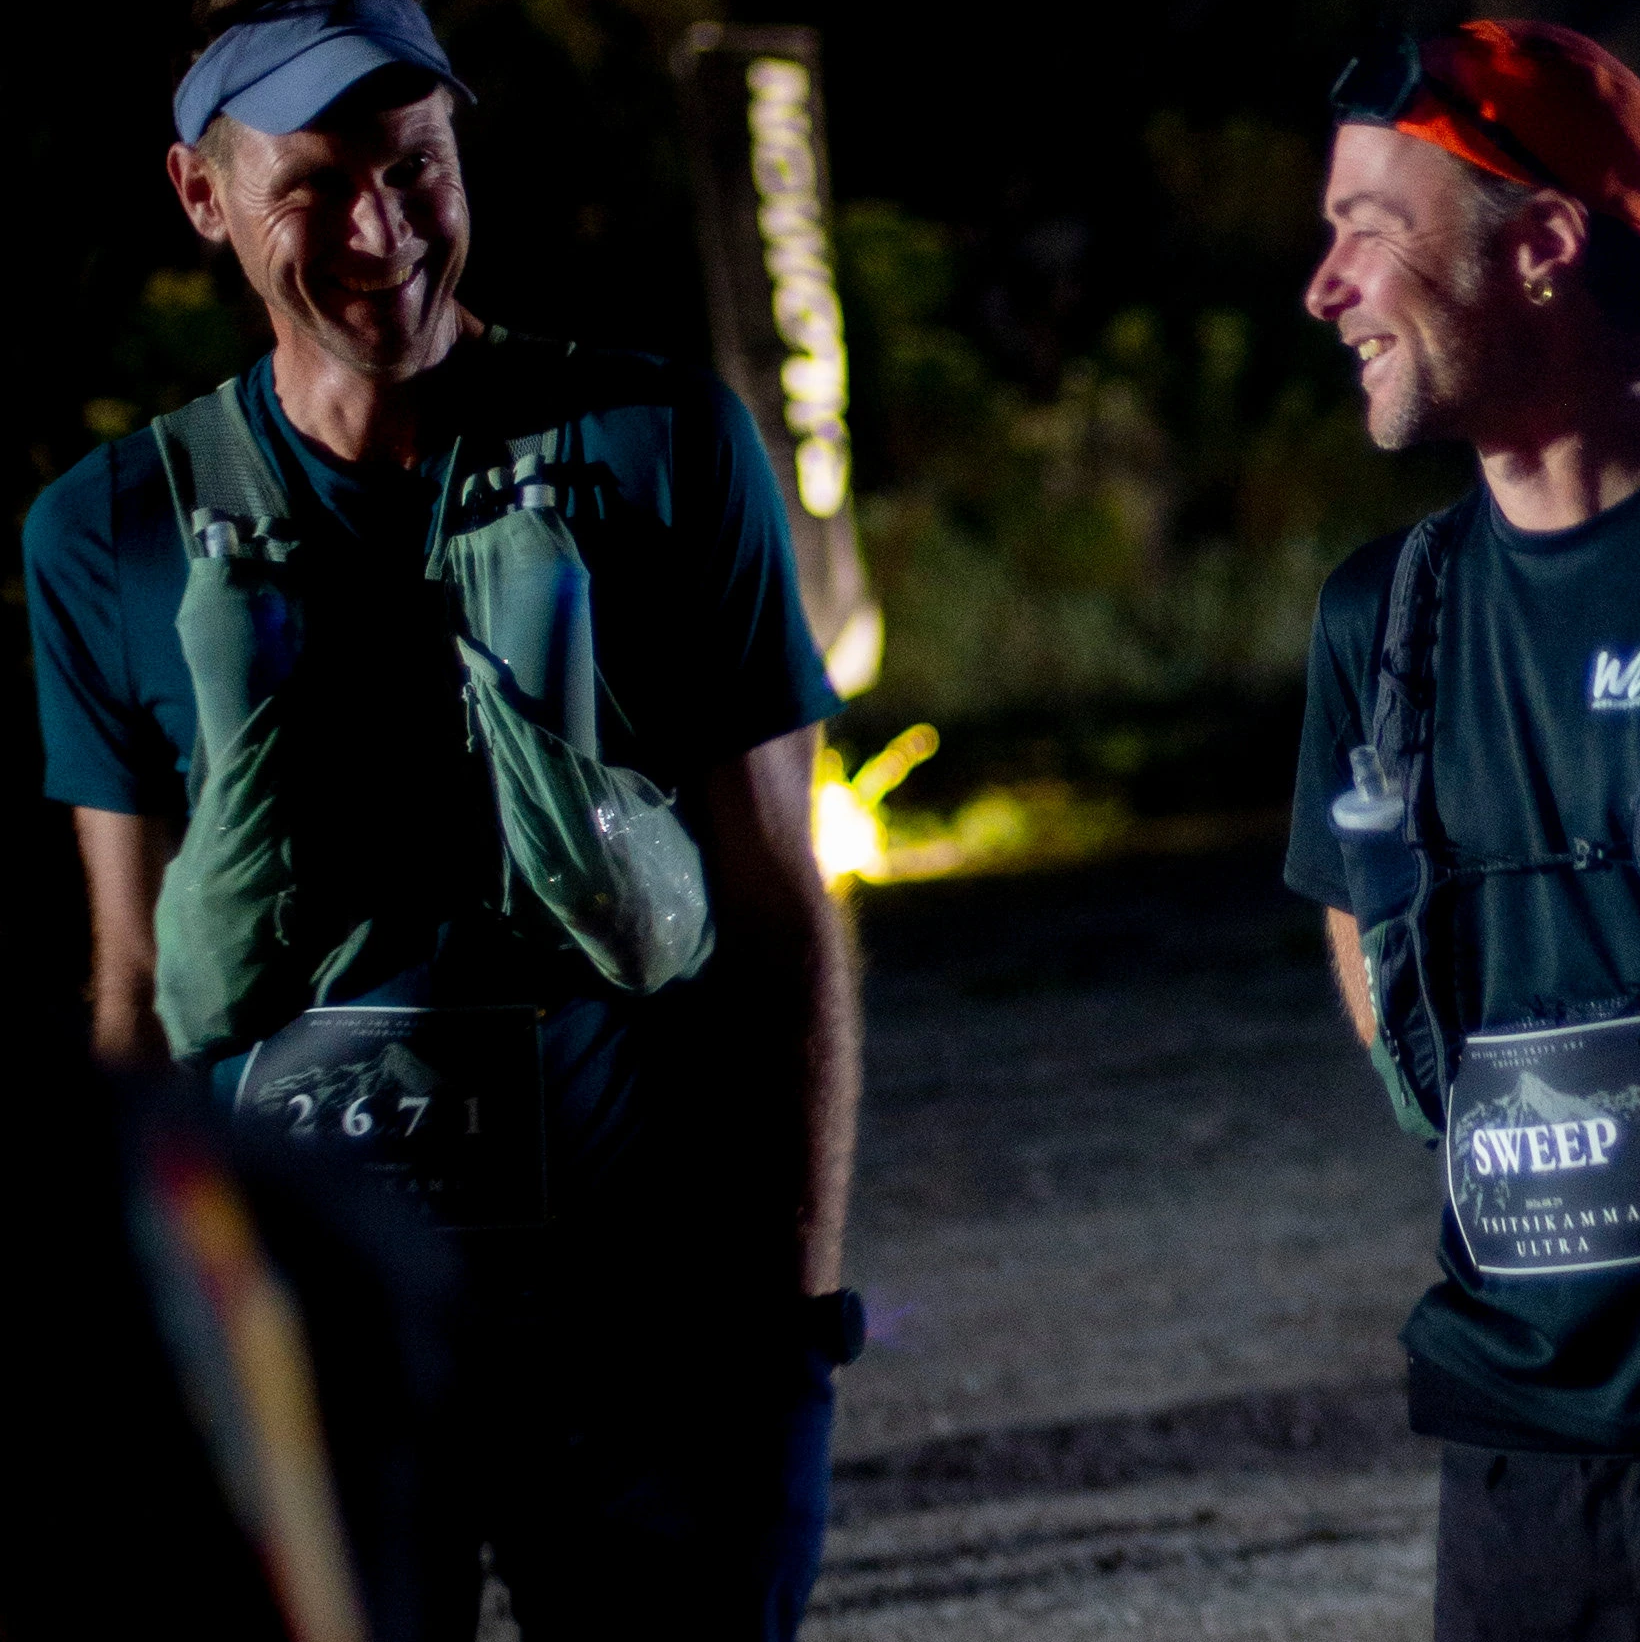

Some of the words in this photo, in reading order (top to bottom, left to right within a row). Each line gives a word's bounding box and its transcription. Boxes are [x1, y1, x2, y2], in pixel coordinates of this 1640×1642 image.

[287, 1093, 482, 1137] 2671
[1472, 1116, 1618, 1176] SWEEP
[1481, 1204, 1640, 1235] TSITSIKAMMA
[1515, 1236, 1591, 1258] ULTRA
